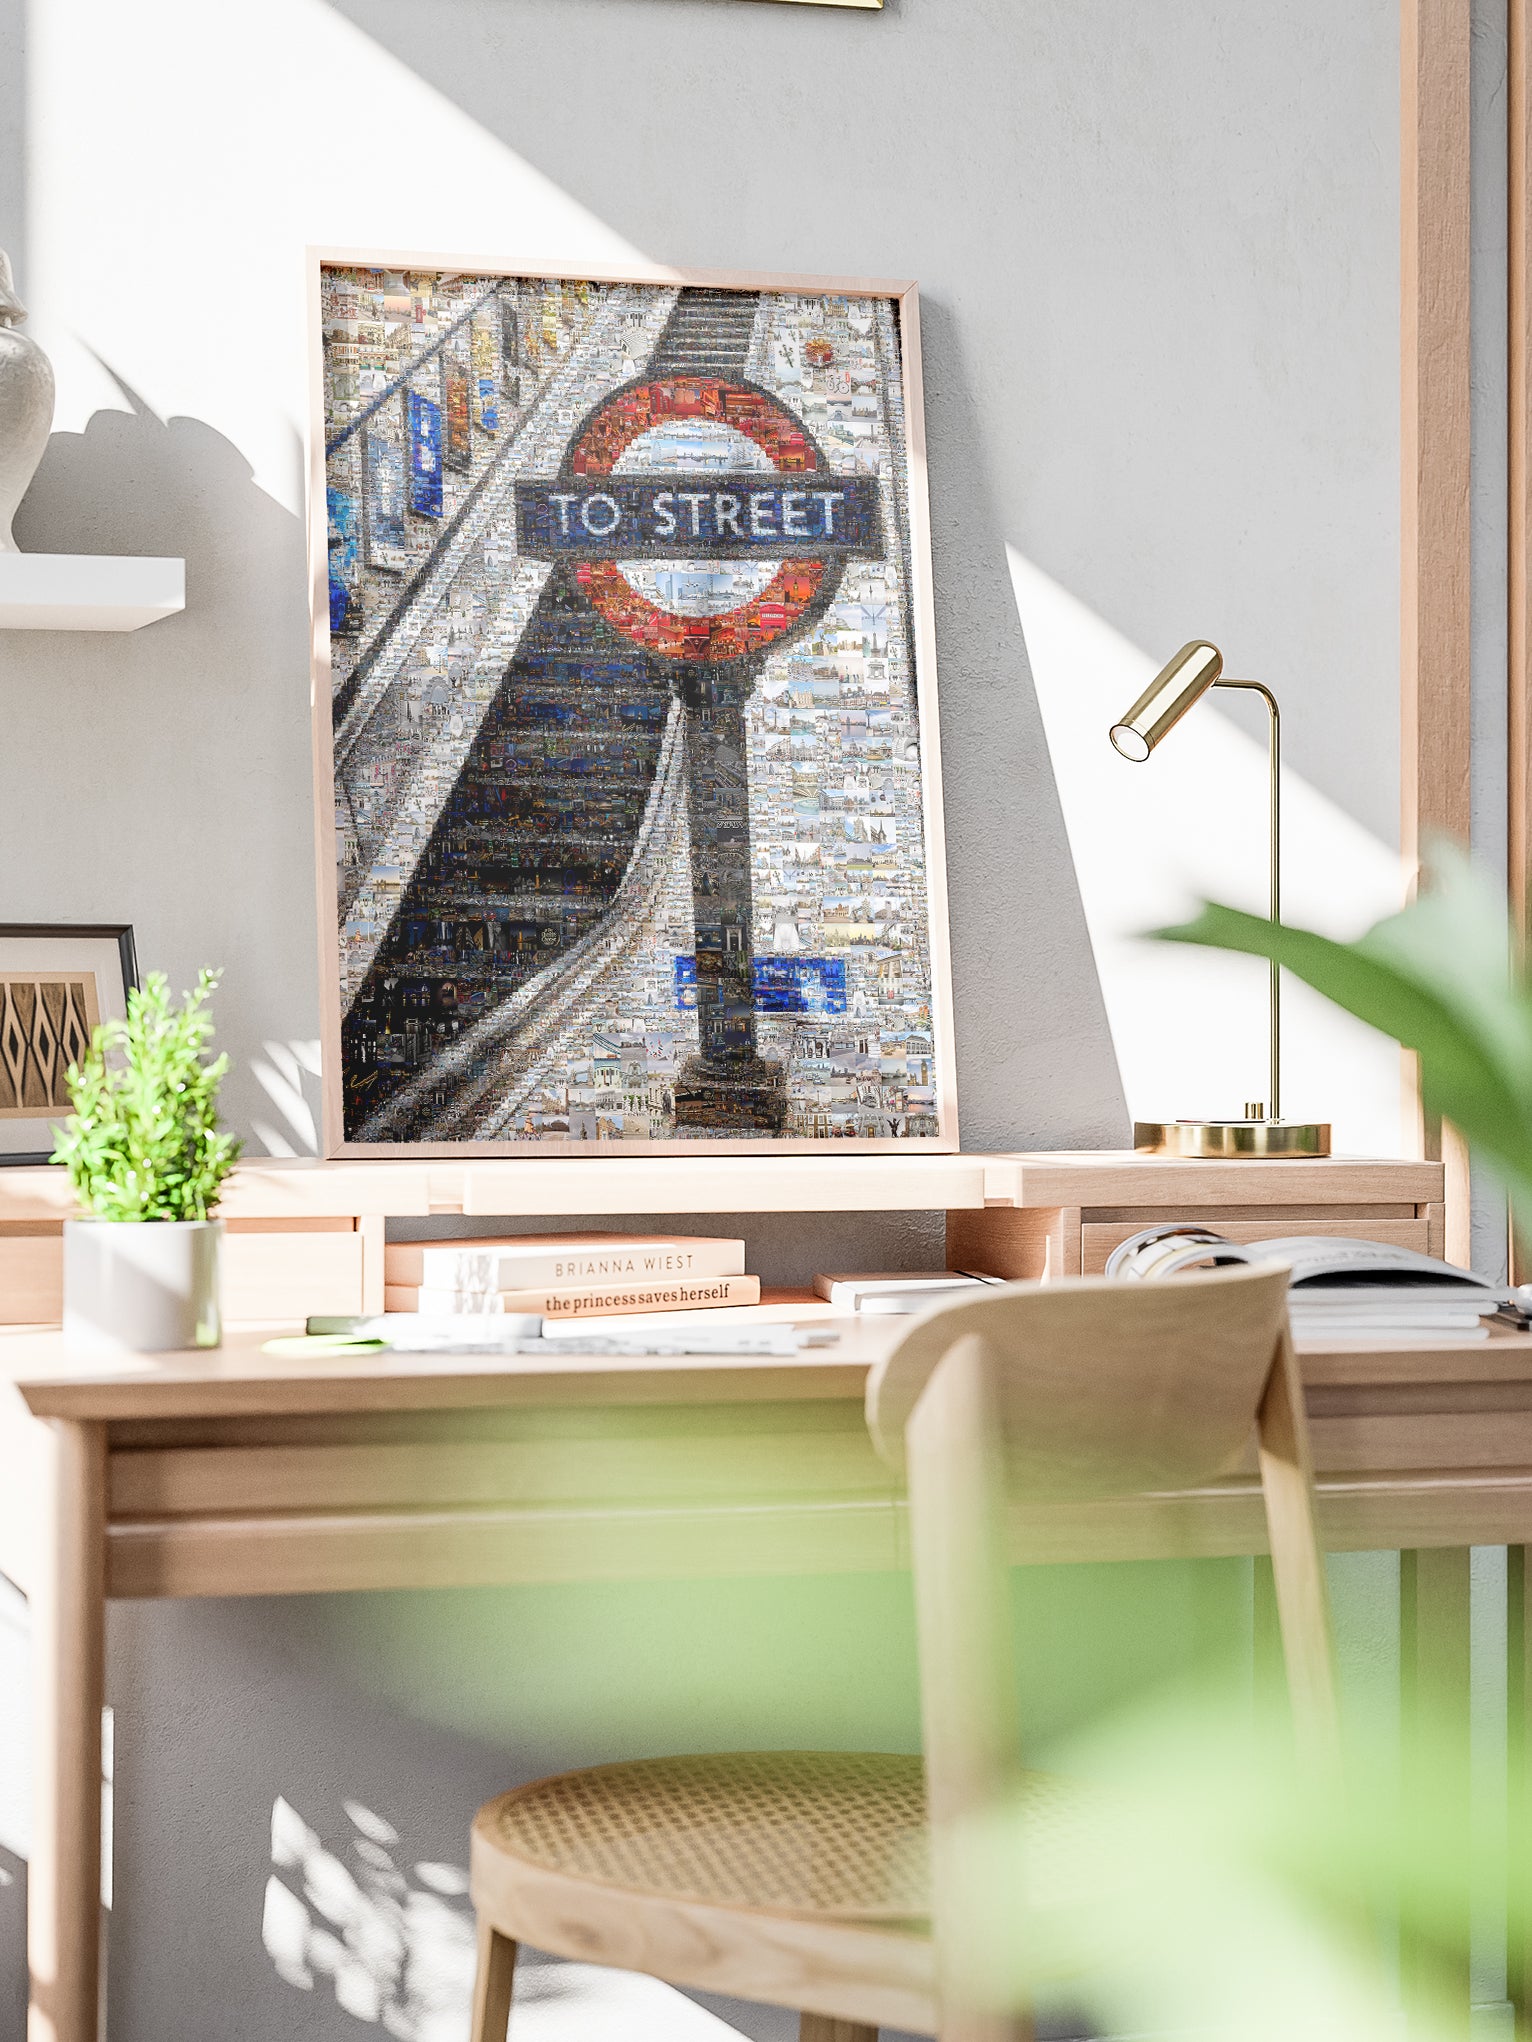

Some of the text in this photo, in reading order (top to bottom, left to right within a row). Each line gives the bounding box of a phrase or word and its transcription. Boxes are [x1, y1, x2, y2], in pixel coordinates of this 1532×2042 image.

[548, 491, 845, 538] TO STREET
[556, 1255, 693, 1277] BRIANNA WIEST
[546, 1296, 571, 1311] the
